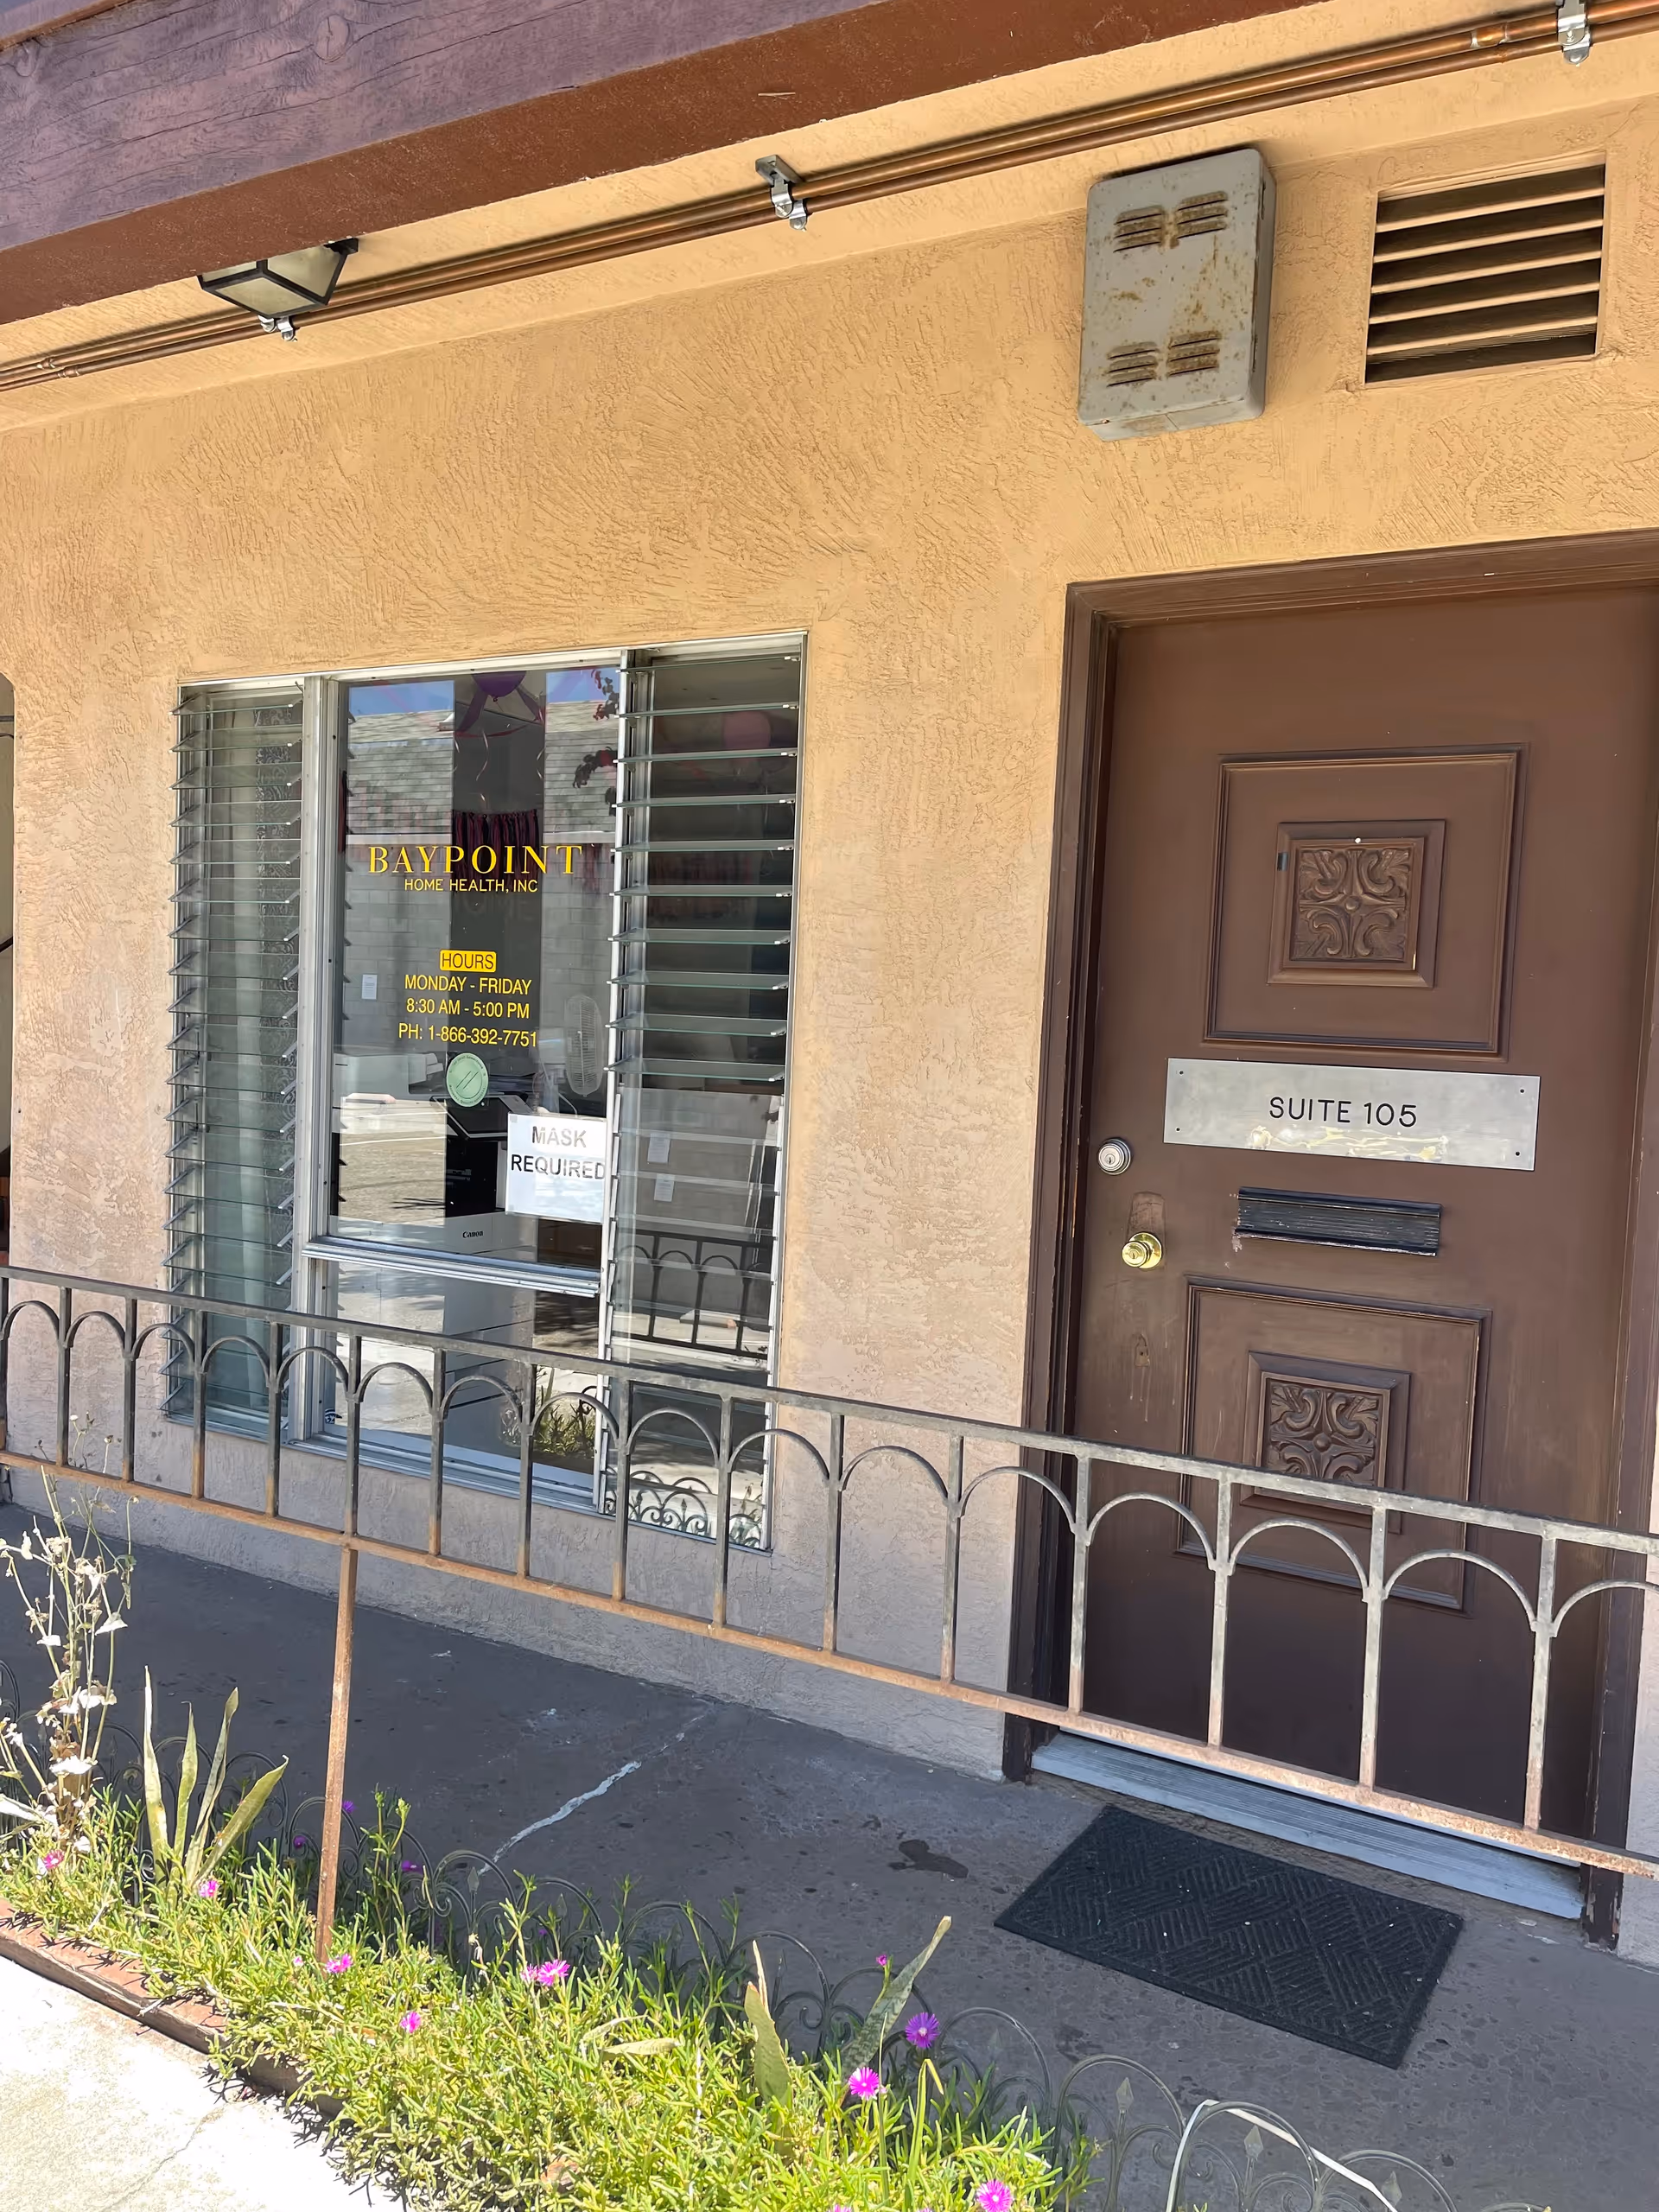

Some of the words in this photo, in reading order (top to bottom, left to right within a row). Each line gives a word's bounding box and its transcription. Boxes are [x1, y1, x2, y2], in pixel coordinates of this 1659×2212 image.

[368, 845, 582, 874] BAYPOINT
[404, 879, 443, 891] HOME
[449, 879, 509, 893] HEALTH,
[513, 879, 538, 893] INC
[442, 953, 494, 969] HOURS
[404, 974, 467, 992] MONDAY
[480, 977, 532, 995] FRIDAY
[406, 997, 435, 1014] 8:30
[438, 999, 461, 1015] AM
[473, 1001, 504, 1018] 5:00
[507, 1002, 530, 1019] PM
[398, 1022, 423, 1039] PH:
[428, 1025, 537, 1047] 1-866-392-7751
[1269, 1096, 1351, 1123] SUITE
[1363, 1103, 1417, 1128] 105
[532, 1126, 587, 1147] MASK
[511, 1154, 605, 1179] REQUIRED
[462, 1230, 484, 1239] Canon
